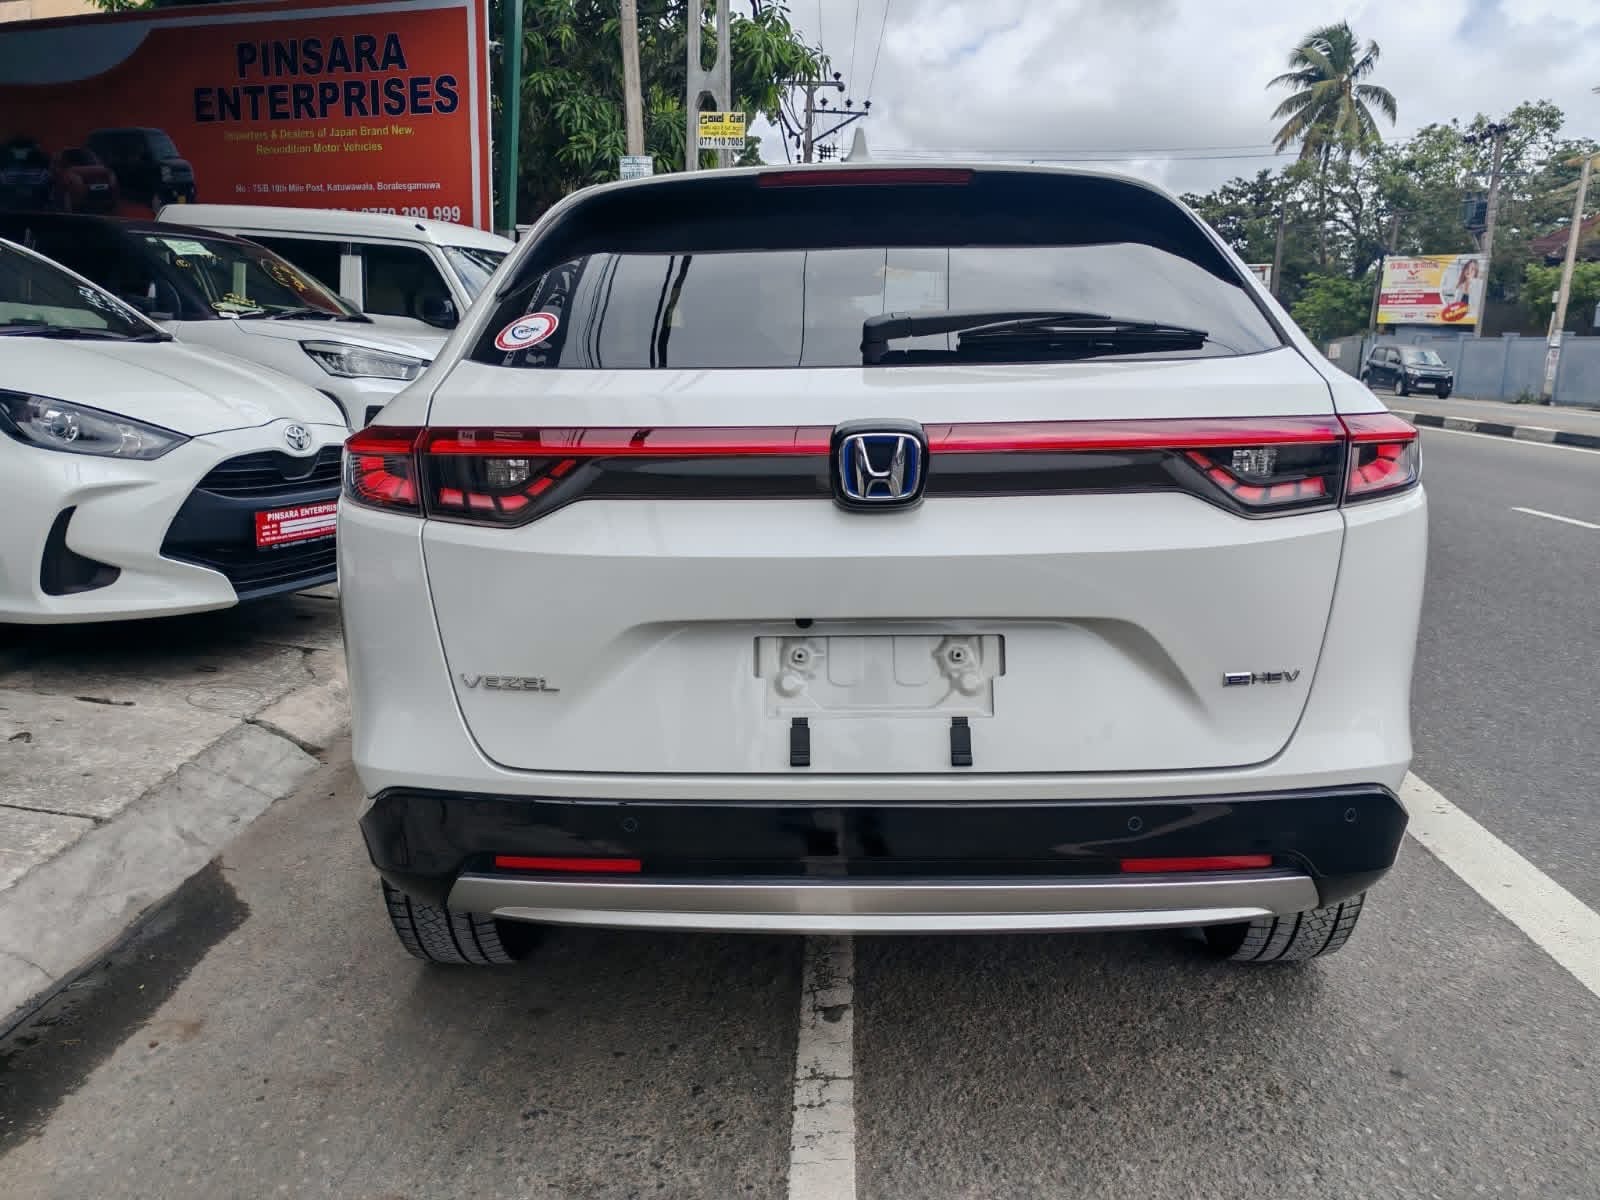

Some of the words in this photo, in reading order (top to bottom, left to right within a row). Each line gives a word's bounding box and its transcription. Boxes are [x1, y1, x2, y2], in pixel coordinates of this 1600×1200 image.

[236, 32, 407, 78] PINSARA
[194, 75, 459, 122] ENTERPRISES
[280, 128, 314, 138] Dealers
[318, 127, 327, 137] of
[329, 127, 358, 139] Japan
[360, 126, 389, 136] Brand
[391, 125, 415, 136] New,
[313, 143, 339, 153] Motor
[343, 142, 383, 152] Vehicles
[699, 137, 712, 146] 077
[433, 205, 461, 222] 999
[267, 510, 299, 522] PINSARA
[461, 673, 560, 692] VEZEL
